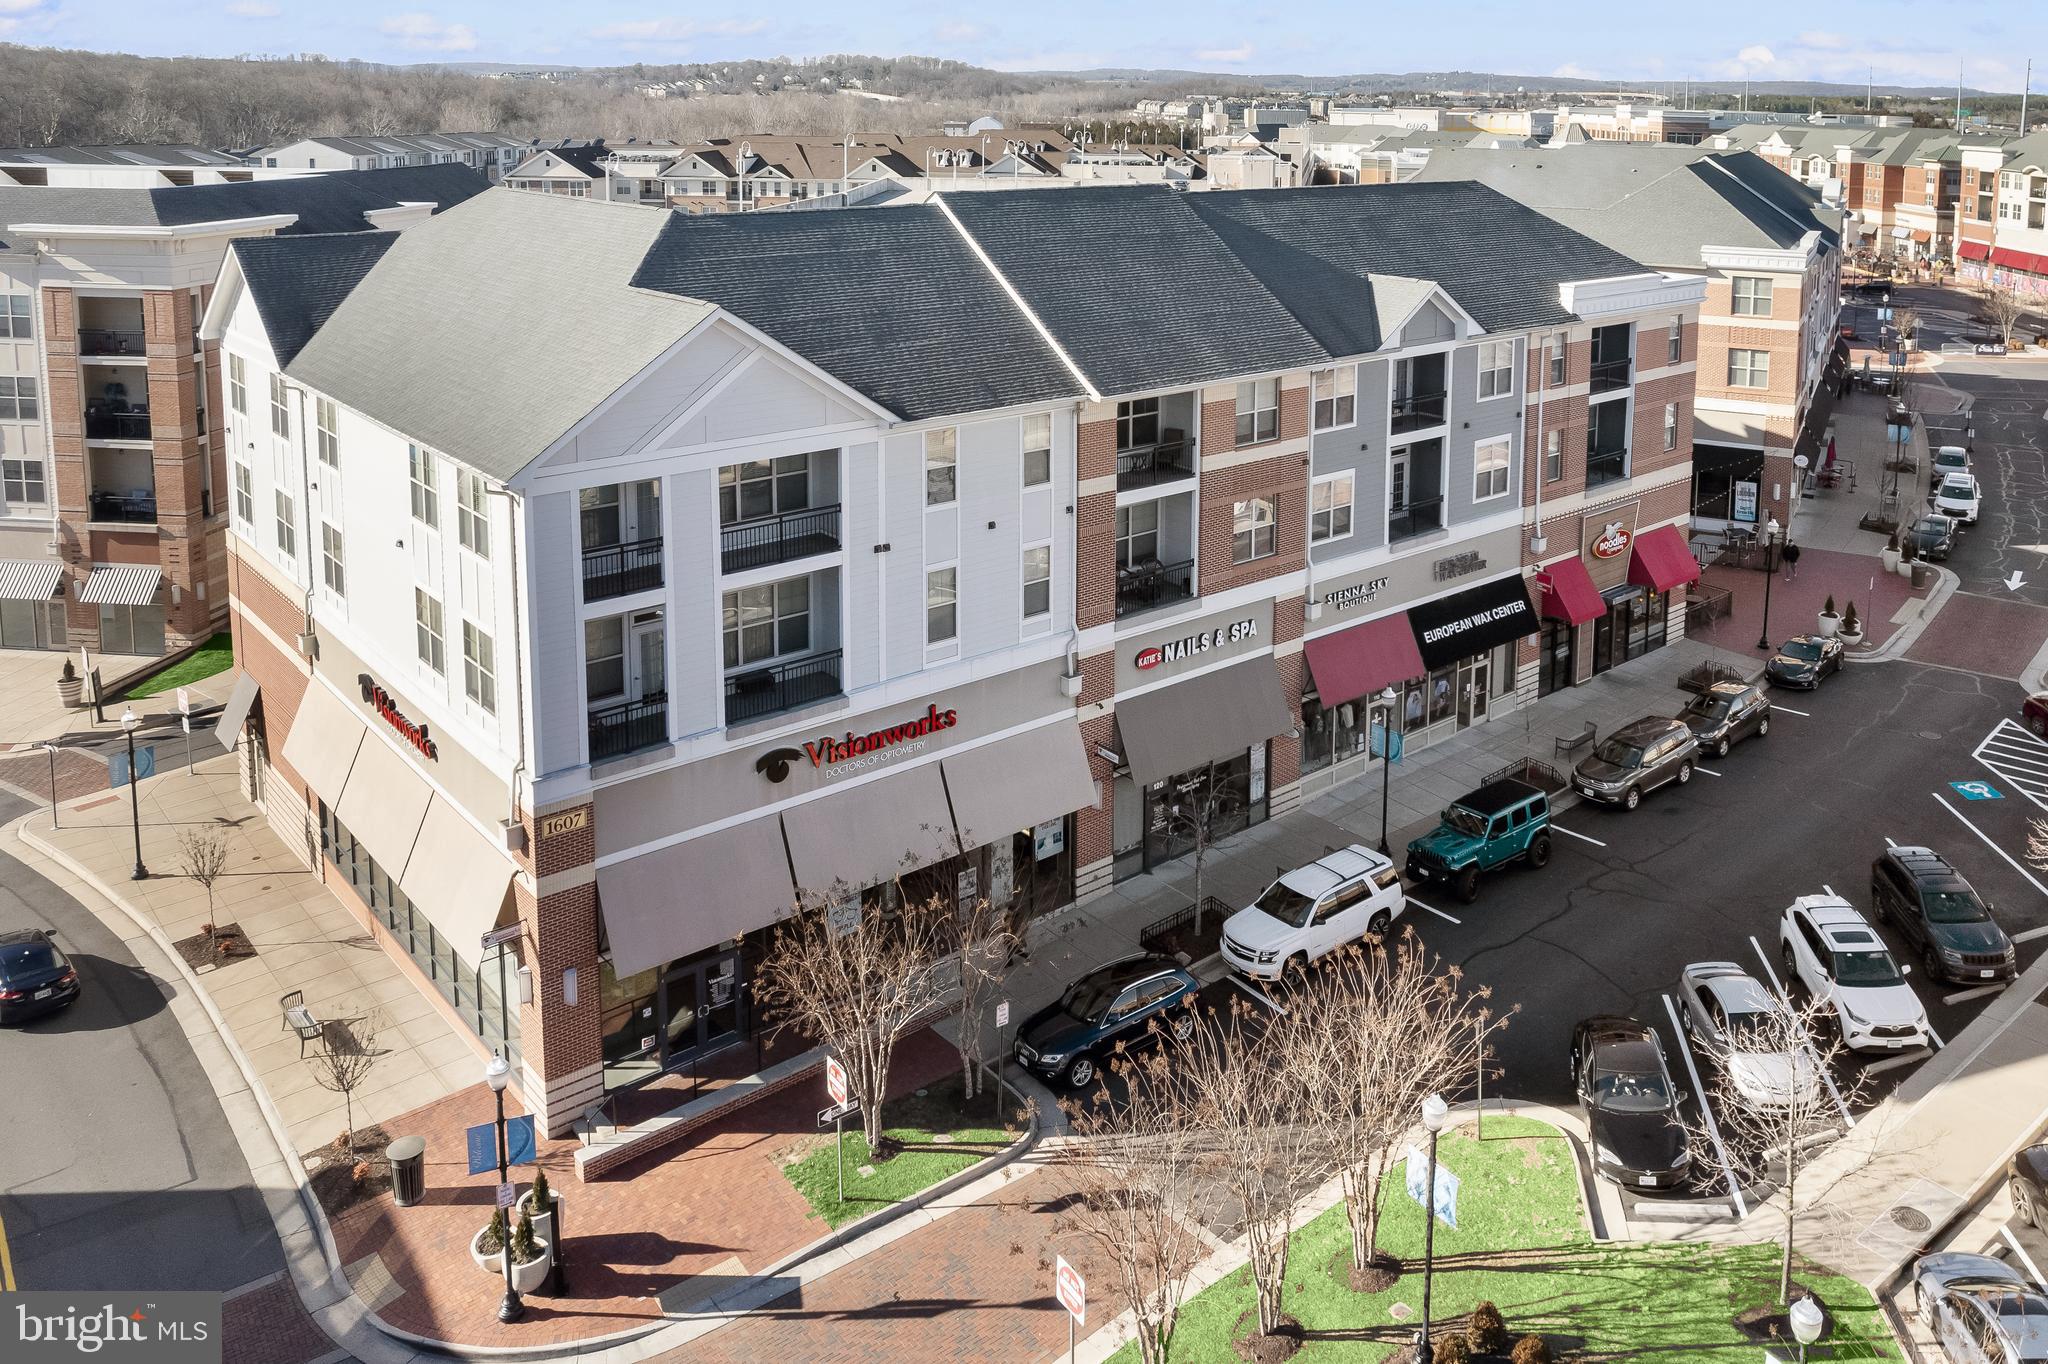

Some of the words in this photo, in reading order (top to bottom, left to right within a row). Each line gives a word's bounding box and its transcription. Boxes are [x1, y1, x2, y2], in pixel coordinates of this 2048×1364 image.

[1599, 532, 1627, 551] noodles
[1326, 584, 1366, 605] SIENNA
[1370, 577, 1389, 592] SKY
[1338, 593, 1377, 611] BOUTIQUE
[1424, 617, 1473, 643] EUROPEAN
[1472, 611, 1493, 626] WAX
[1492, 600, 1527, 619] CENTER
[1163, 633, 1210, 663] NAILS
[1215, 629, 1225, 647] &
[1230, 619, 1258, 642] SPA
[1138, 651, 1162, 667] KATIE'S
[372, 684, 437, 760] Visionworks
[803, 703, 957, 769] Visionworks
[826, 758, 865, 779] DOCTORS
[867, 754, 879, 766] OF
[880, 740, 926, 762] OPTOMETRY
[1153, 780, 1164, 791] 120
[546, 813, 582, 835] 1607
